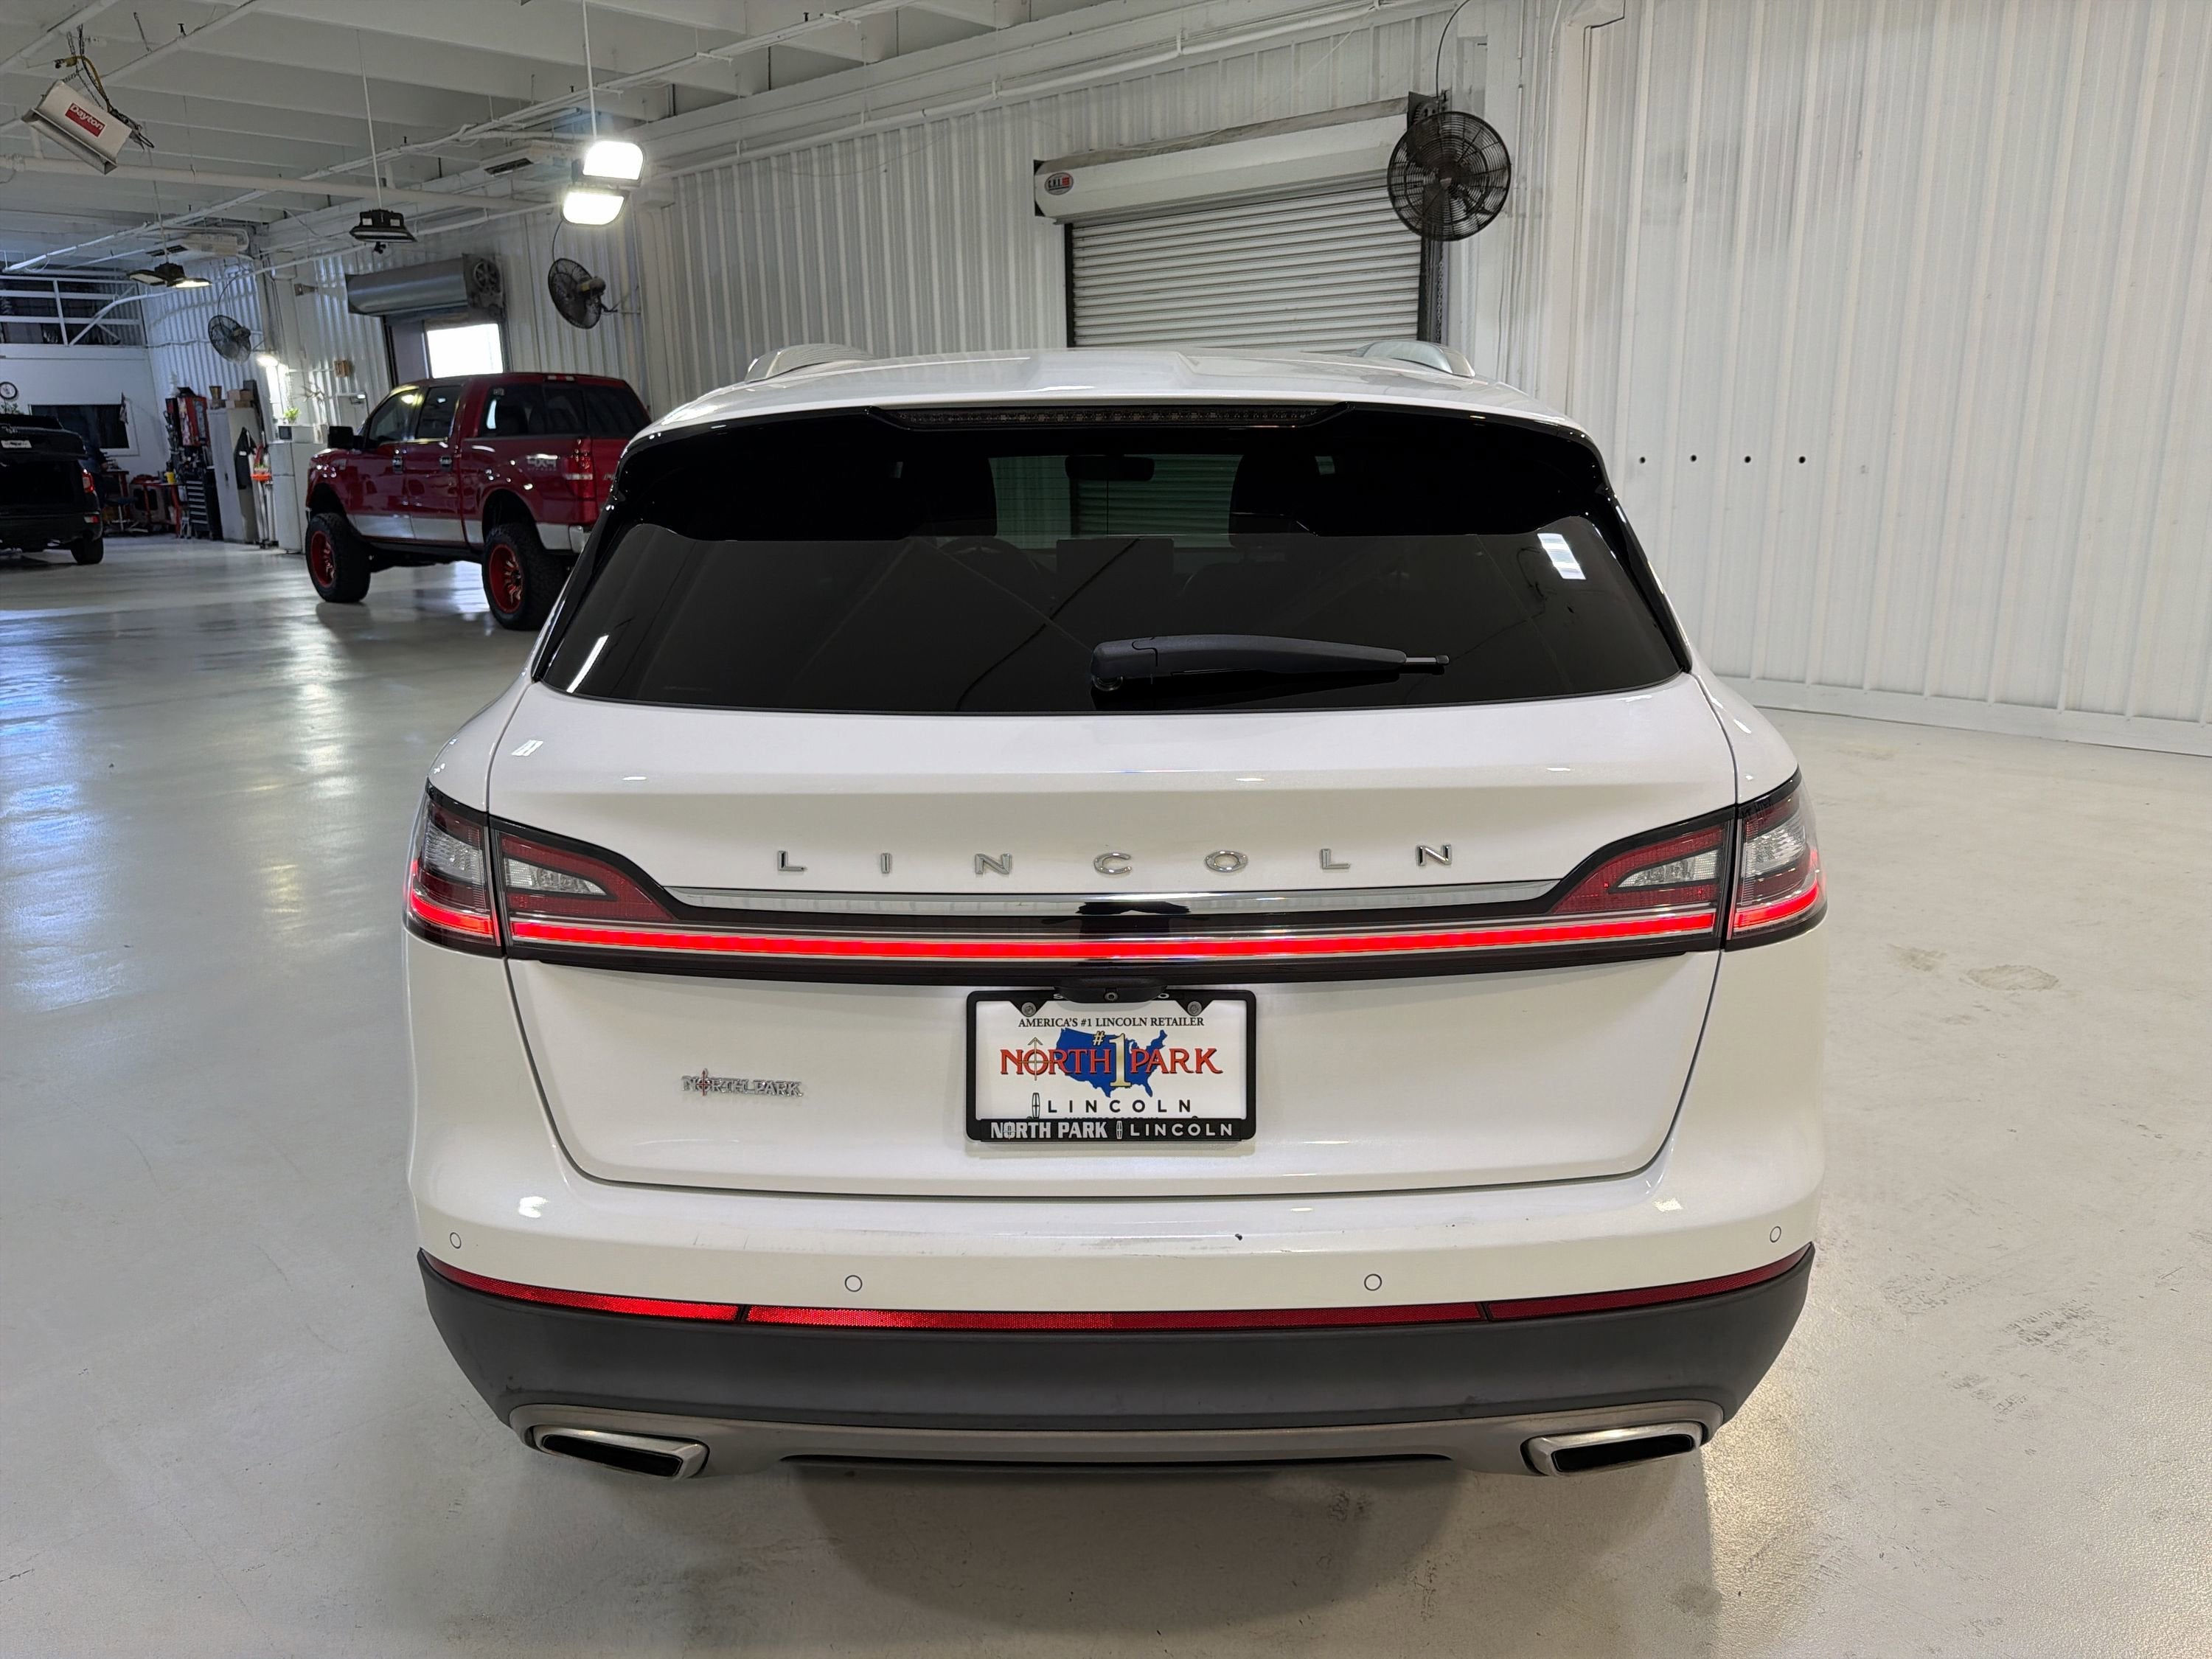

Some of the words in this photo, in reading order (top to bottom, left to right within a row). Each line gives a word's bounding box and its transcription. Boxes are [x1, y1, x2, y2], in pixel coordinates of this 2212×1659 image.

[70, 104, 103, 130] Dayton
[777, 844, 1453, 875] LINCOLN
[1018, 1018, 1078, 1027] AMERICA'S
[1081, 1018, 1092, 1027] #1
[1096, 1018, 1147, 1026] LINCOLN
[1150, 1018, 1204, 1026] RETAILER
[1001, 1048, 1112, 1076] NORTH
[1130, 1048, 1223, 1074] PARK
[682, 1075, 749, 1095] NORTH
[753, 1079, 804, 1097] PARK
[1048, 1099, 1191, 1113] LINCOLN
[990, 1121, 1051, 1139] NORTH
[1058, 1121, 1108, 1138] PARK
[1130, 1122, 1233, 1137] LINCOLN
